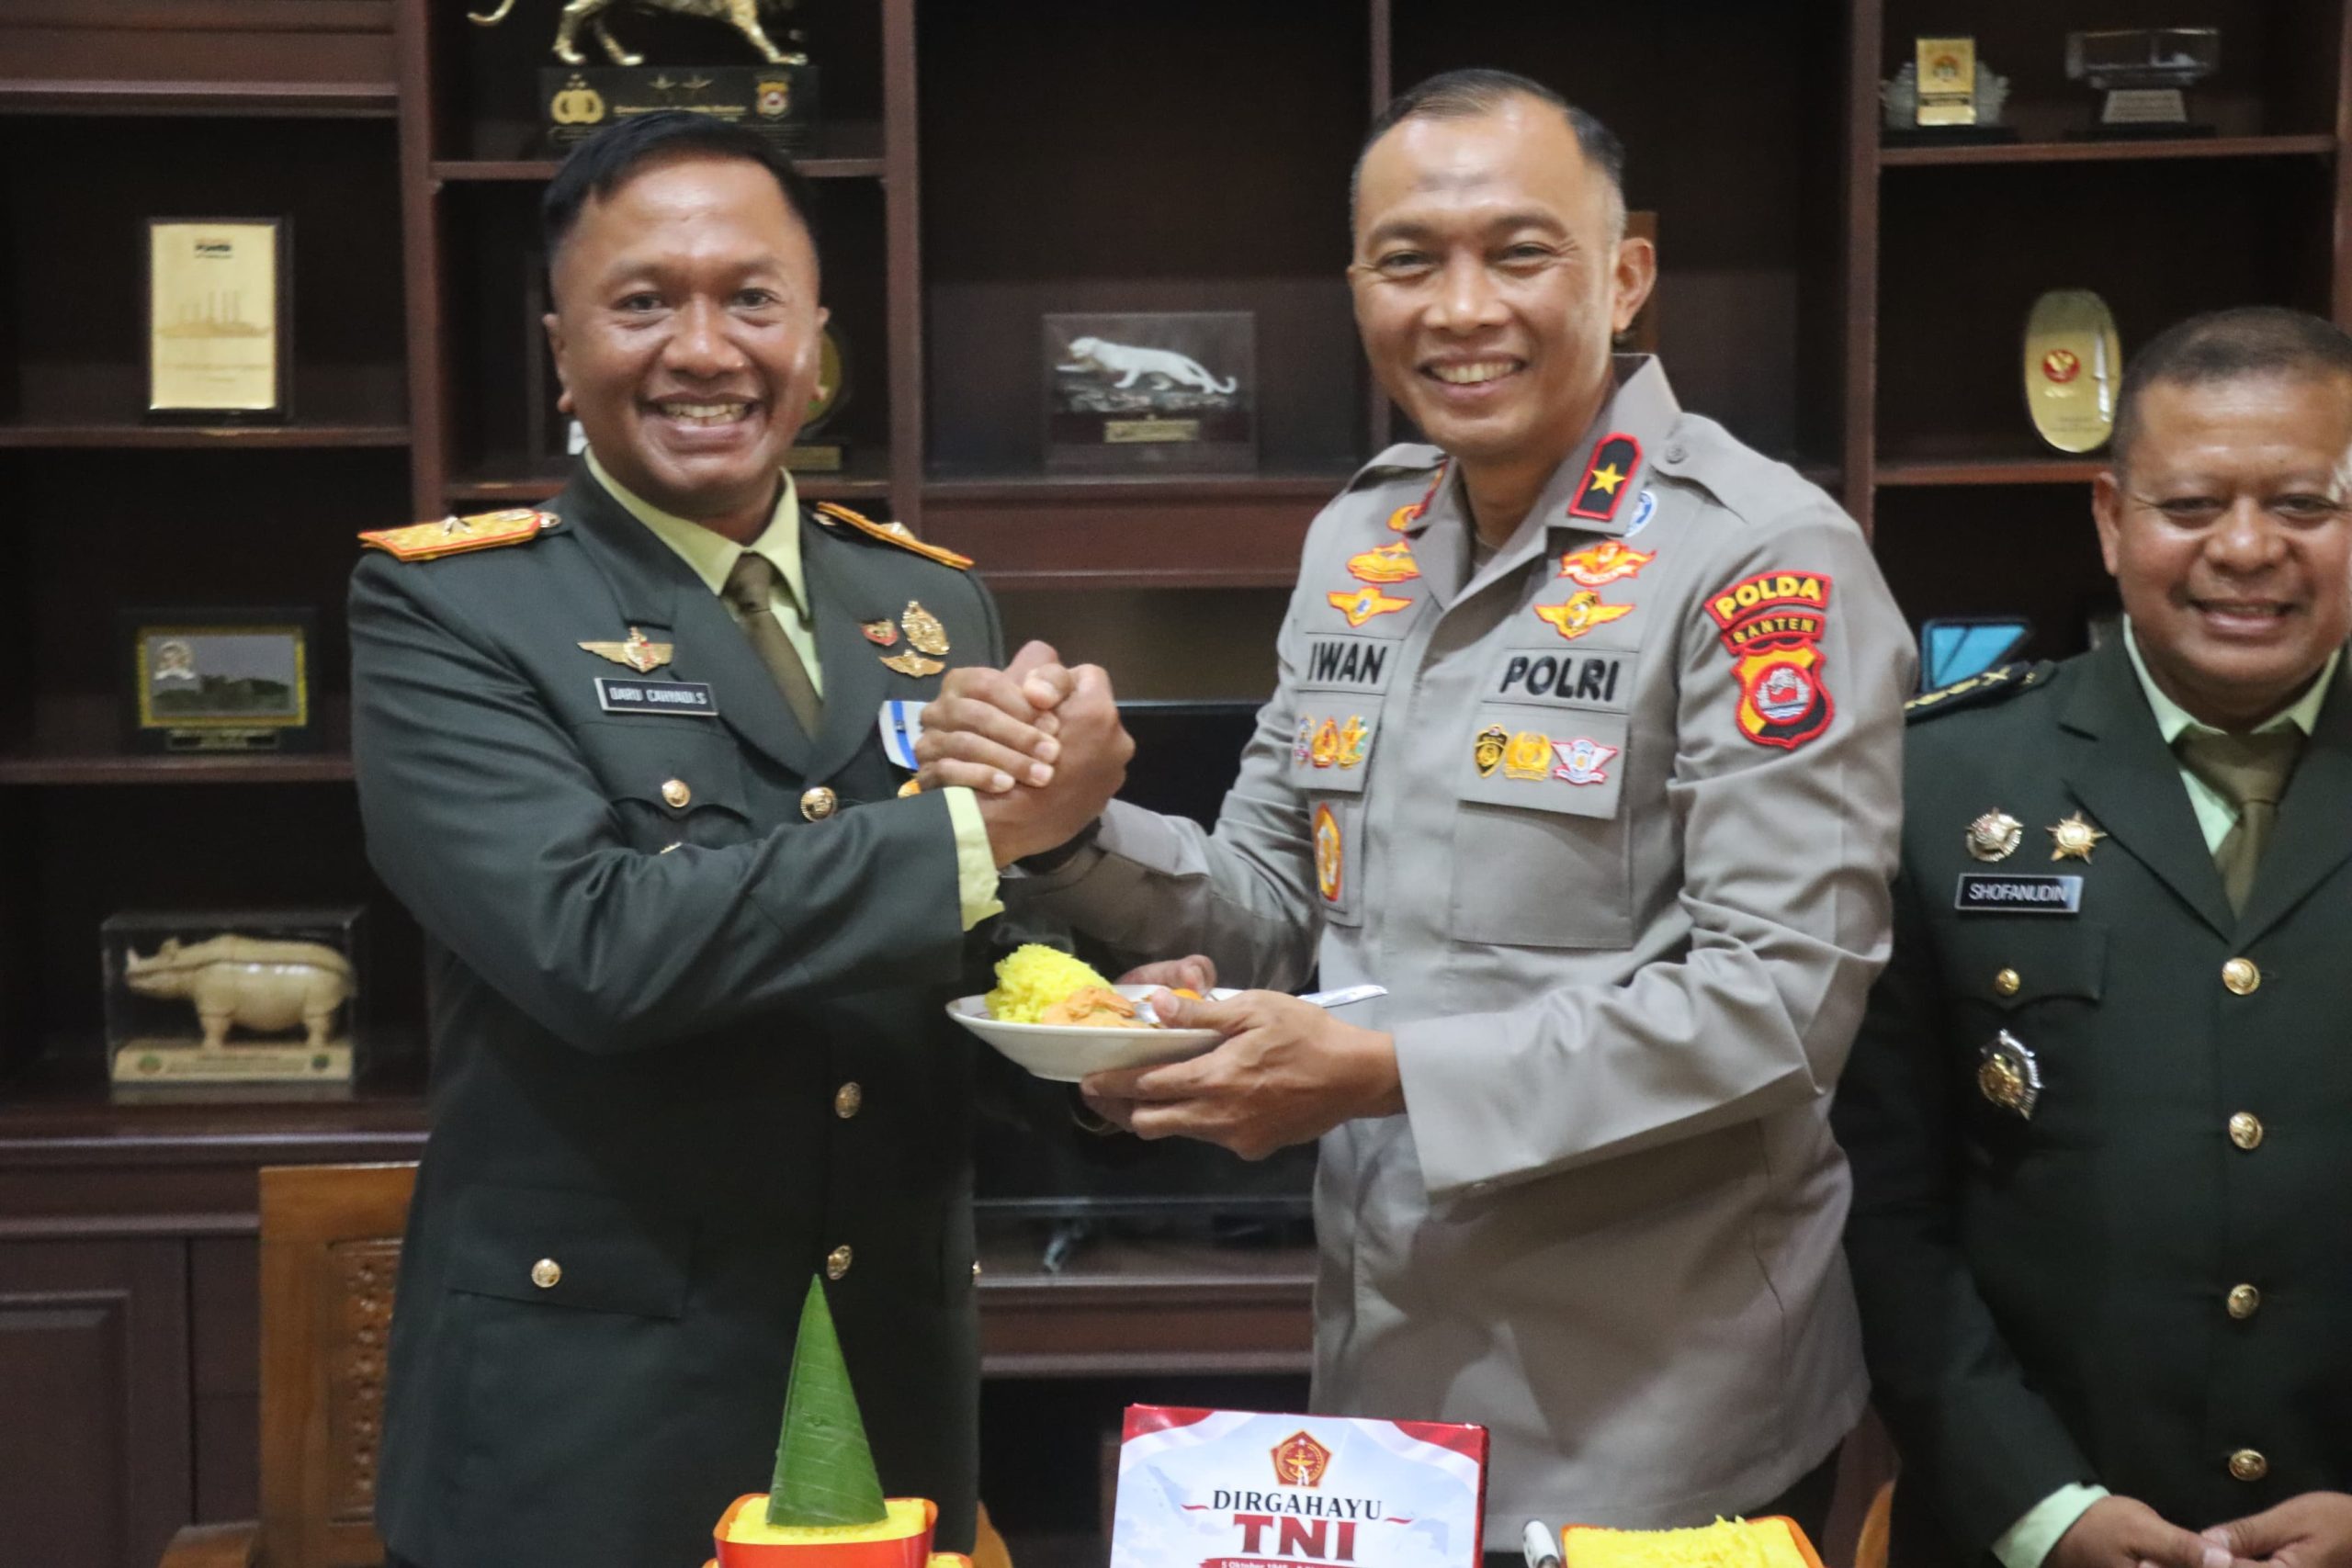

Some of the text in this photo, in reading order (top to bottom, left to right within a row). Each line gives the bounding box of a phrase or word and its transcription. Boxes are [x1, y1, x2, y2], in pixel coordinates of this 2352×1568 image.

[1714, 576, 1822, 620] POLDA
[1732, 617, 1815, 644] BANTEN
[1307, 641, 1388, 685] IWAN
[1498, 655, 1621, 703] POLRI
[1213, 1489, 1383, 1521] DIRGAHAYU
[1233, 1513, 1358, 1562] TNI
